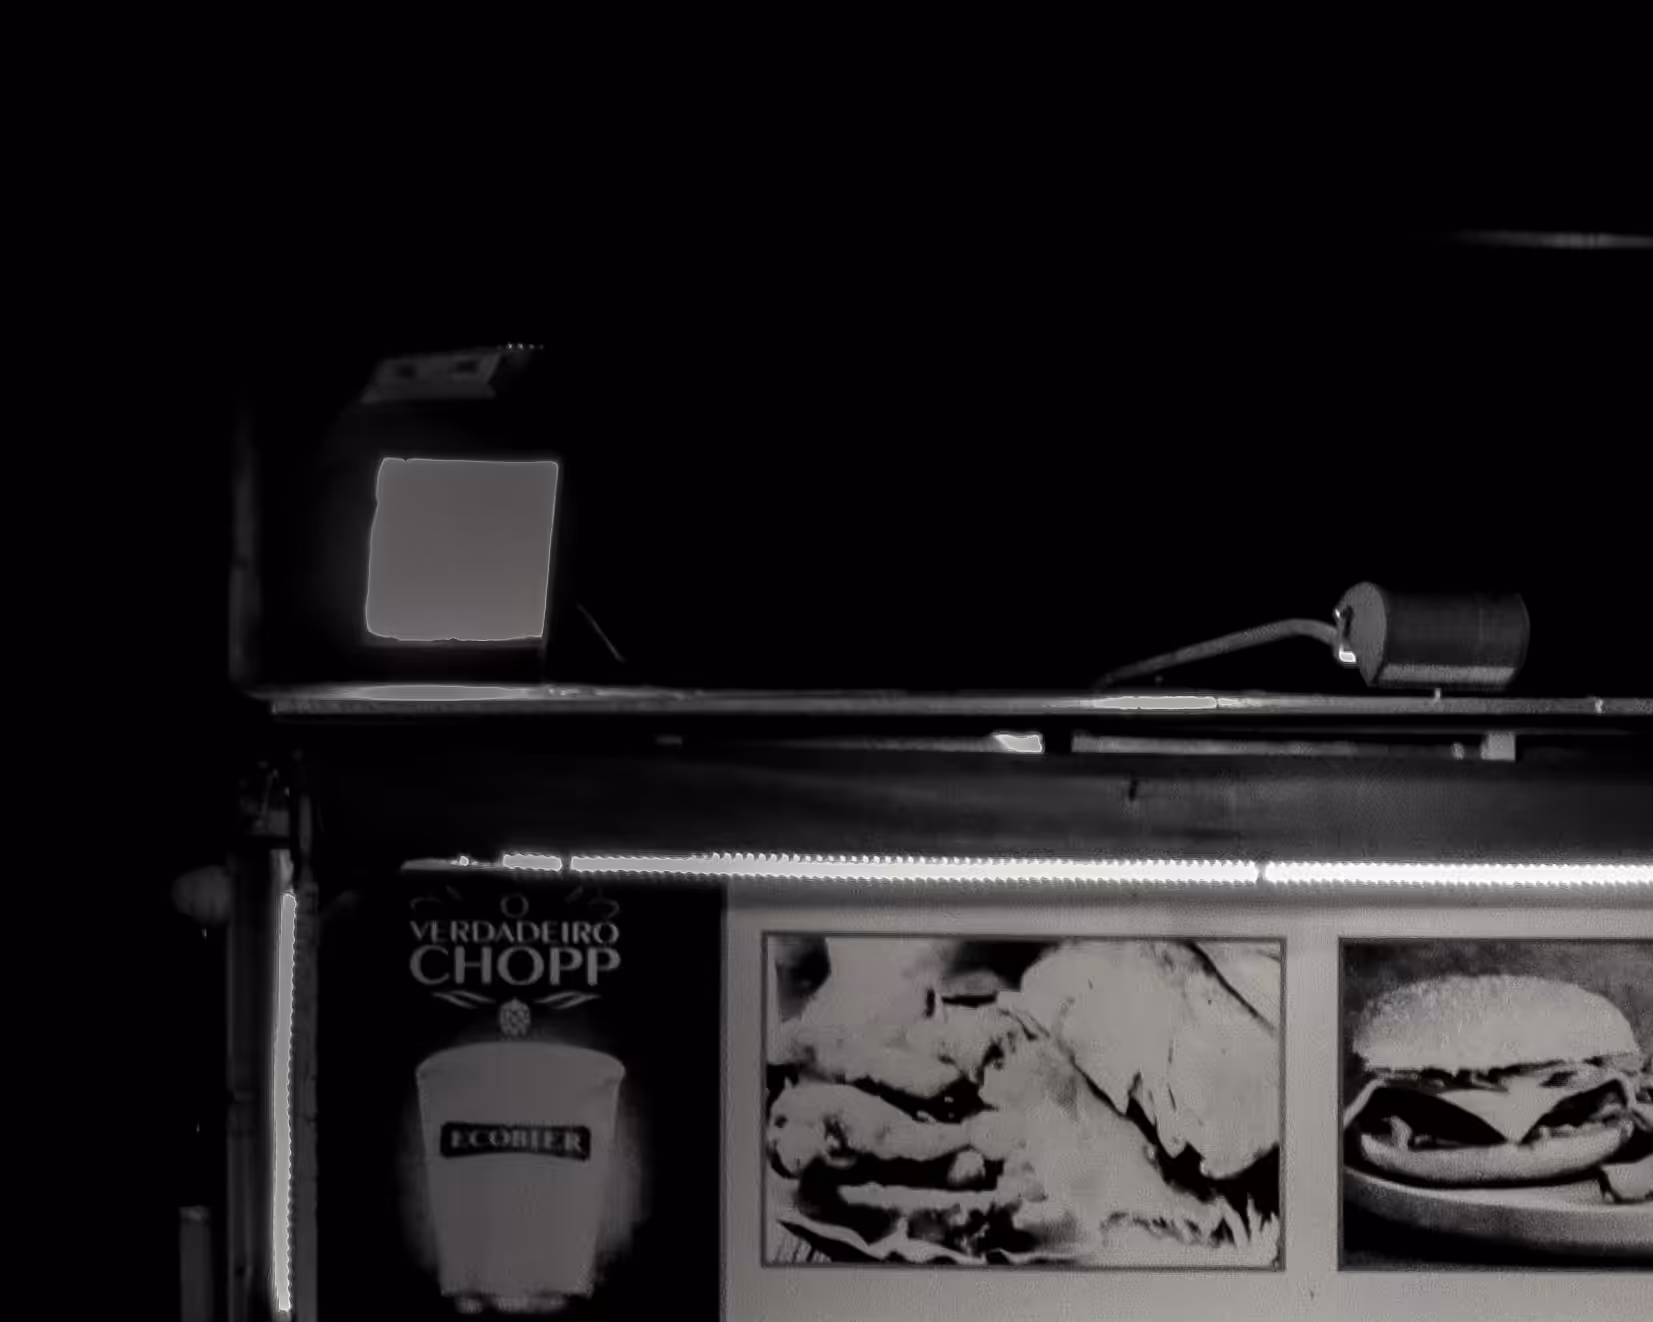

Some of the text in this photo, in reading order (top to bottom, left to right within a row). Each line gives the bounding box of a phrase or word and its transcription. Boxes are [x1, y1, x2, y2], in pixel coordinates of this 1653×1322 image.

[499, 892, 530, 919] O
[409, 920, 621, 945] VERDADEIRO
[408, 945, 622, 987] CHOPP
[449, 1128, 585, 1153] ECOBIER
